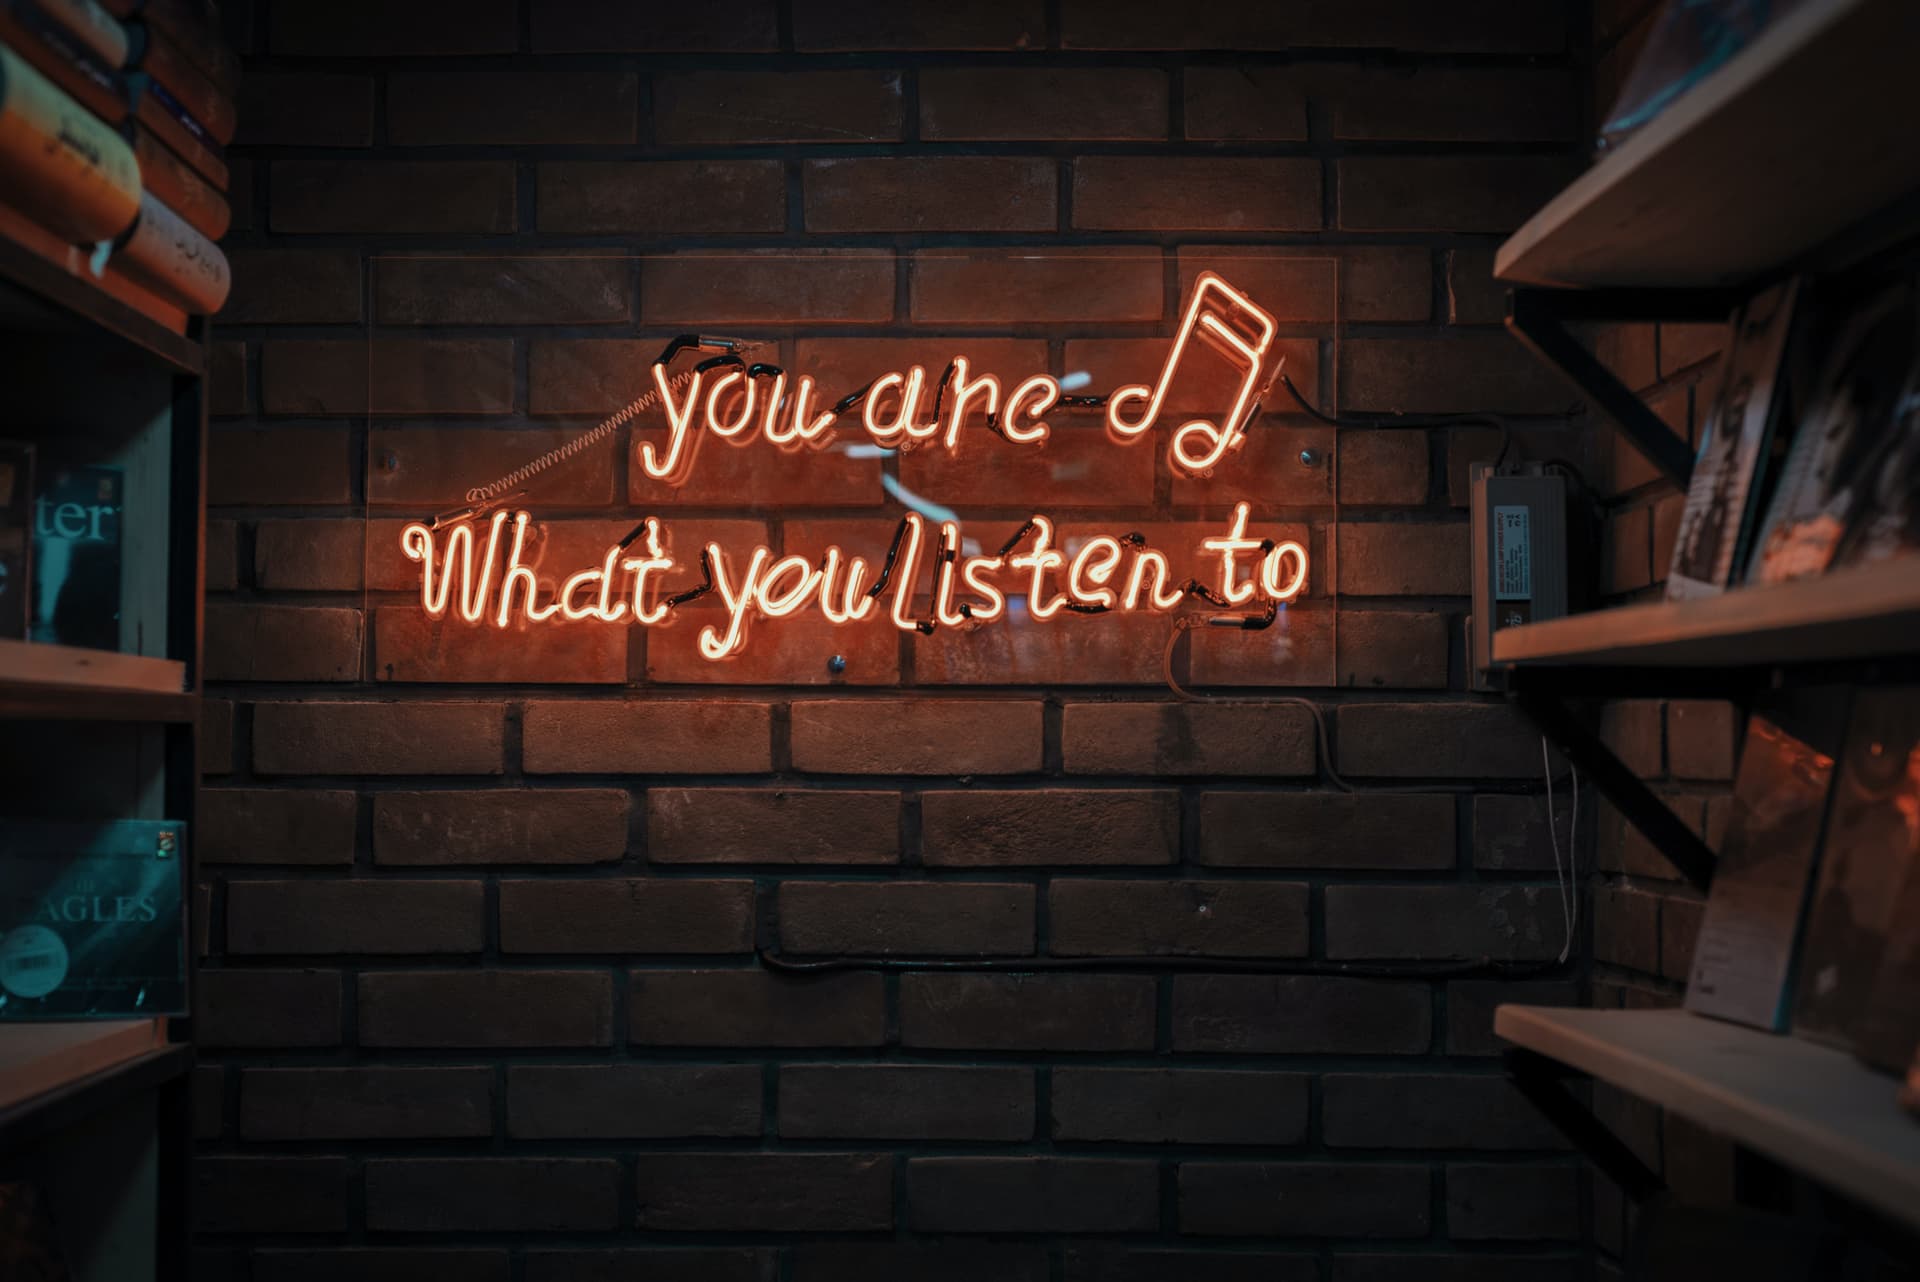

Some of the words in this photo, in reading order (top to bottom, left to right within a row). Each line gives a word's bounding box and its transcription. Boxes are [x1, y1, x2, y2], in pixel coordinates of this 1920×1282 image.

[639, 362, 840, 477] you
[863, 355, 1059, 450] are
[400, 511, 675, 628] What
[699, 542, 876, 660] you
[1203, 502, 1307, 604] to
